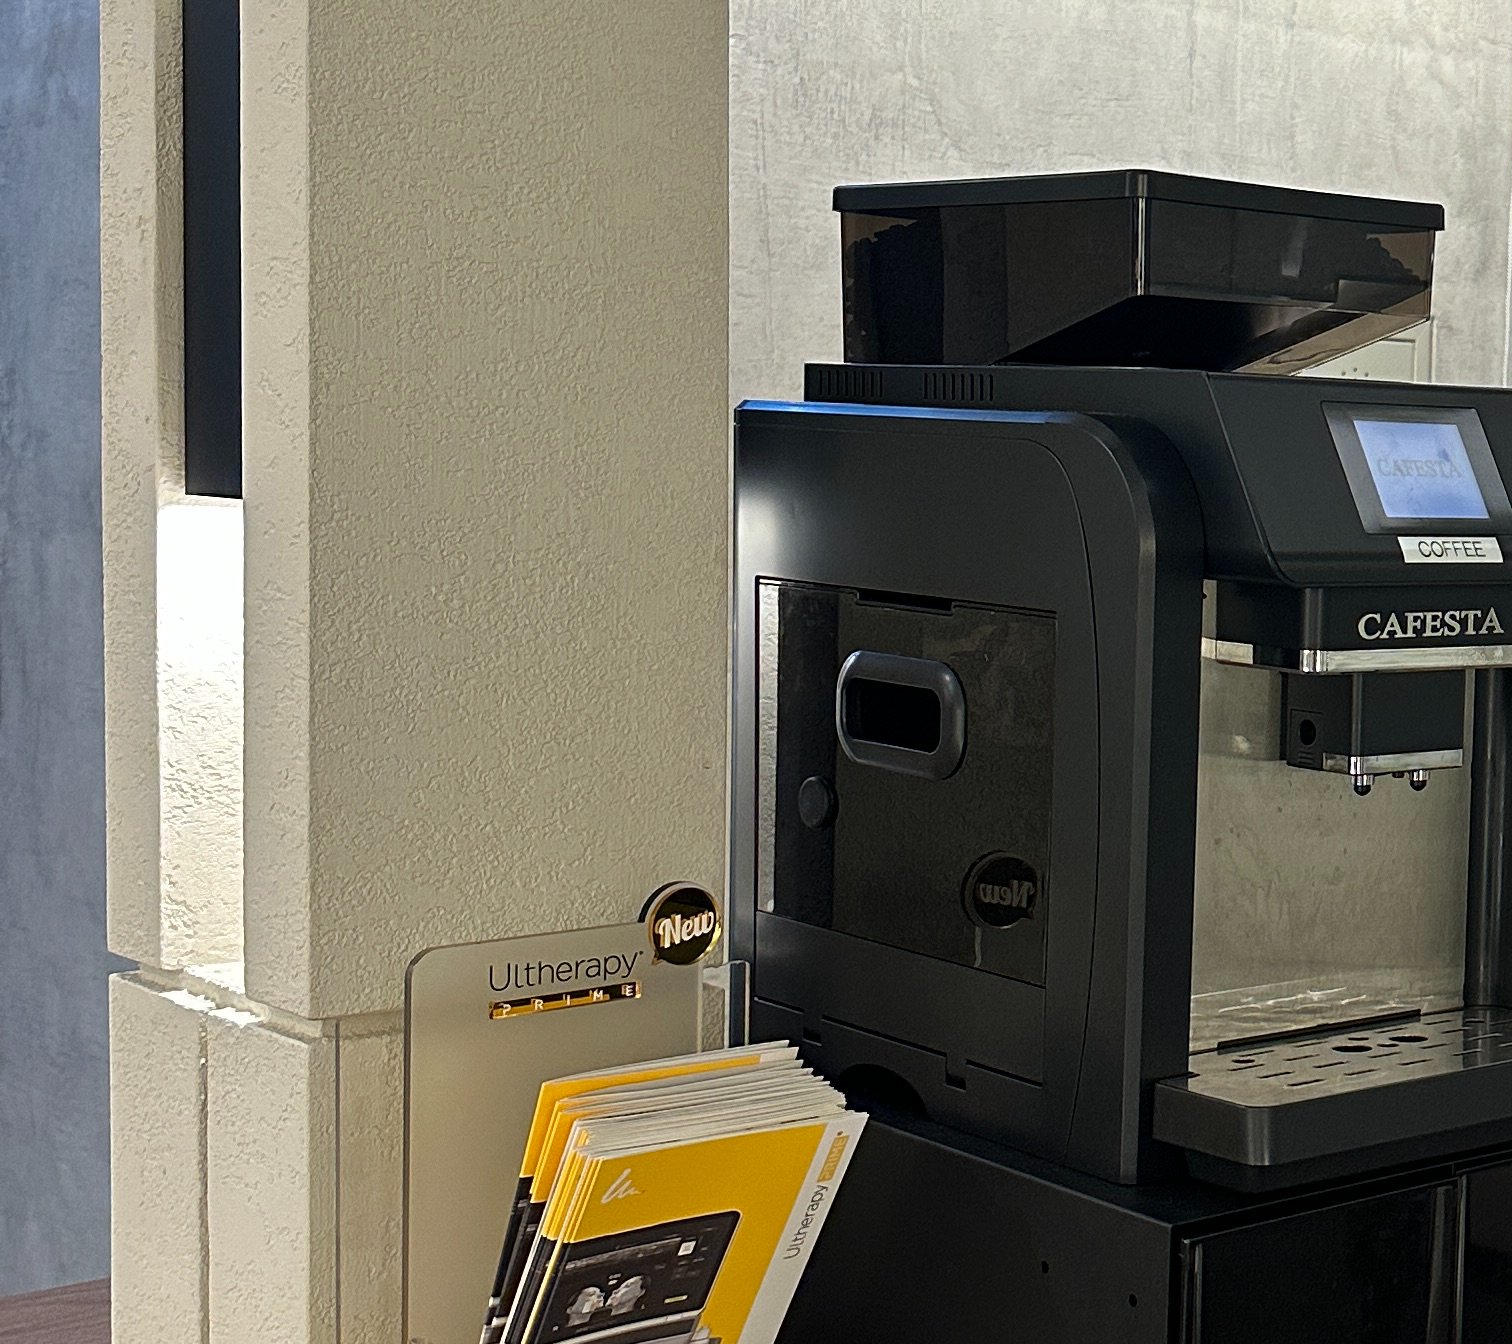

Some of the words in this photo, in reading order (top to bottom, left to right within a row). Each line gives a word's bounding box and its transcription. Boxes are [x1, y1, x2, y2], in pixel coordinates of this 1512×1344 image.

[1418, 540, 1487, 559] COFFEE
[1357, 607, 1505, 641] CAFESTA
[654, 911, 714, 950] New
[489, 950, 640, 993] Ultherapy
[501, 983, 635, 1016] PRIME
[783, 1184, 829, 1259] Ultherapy
